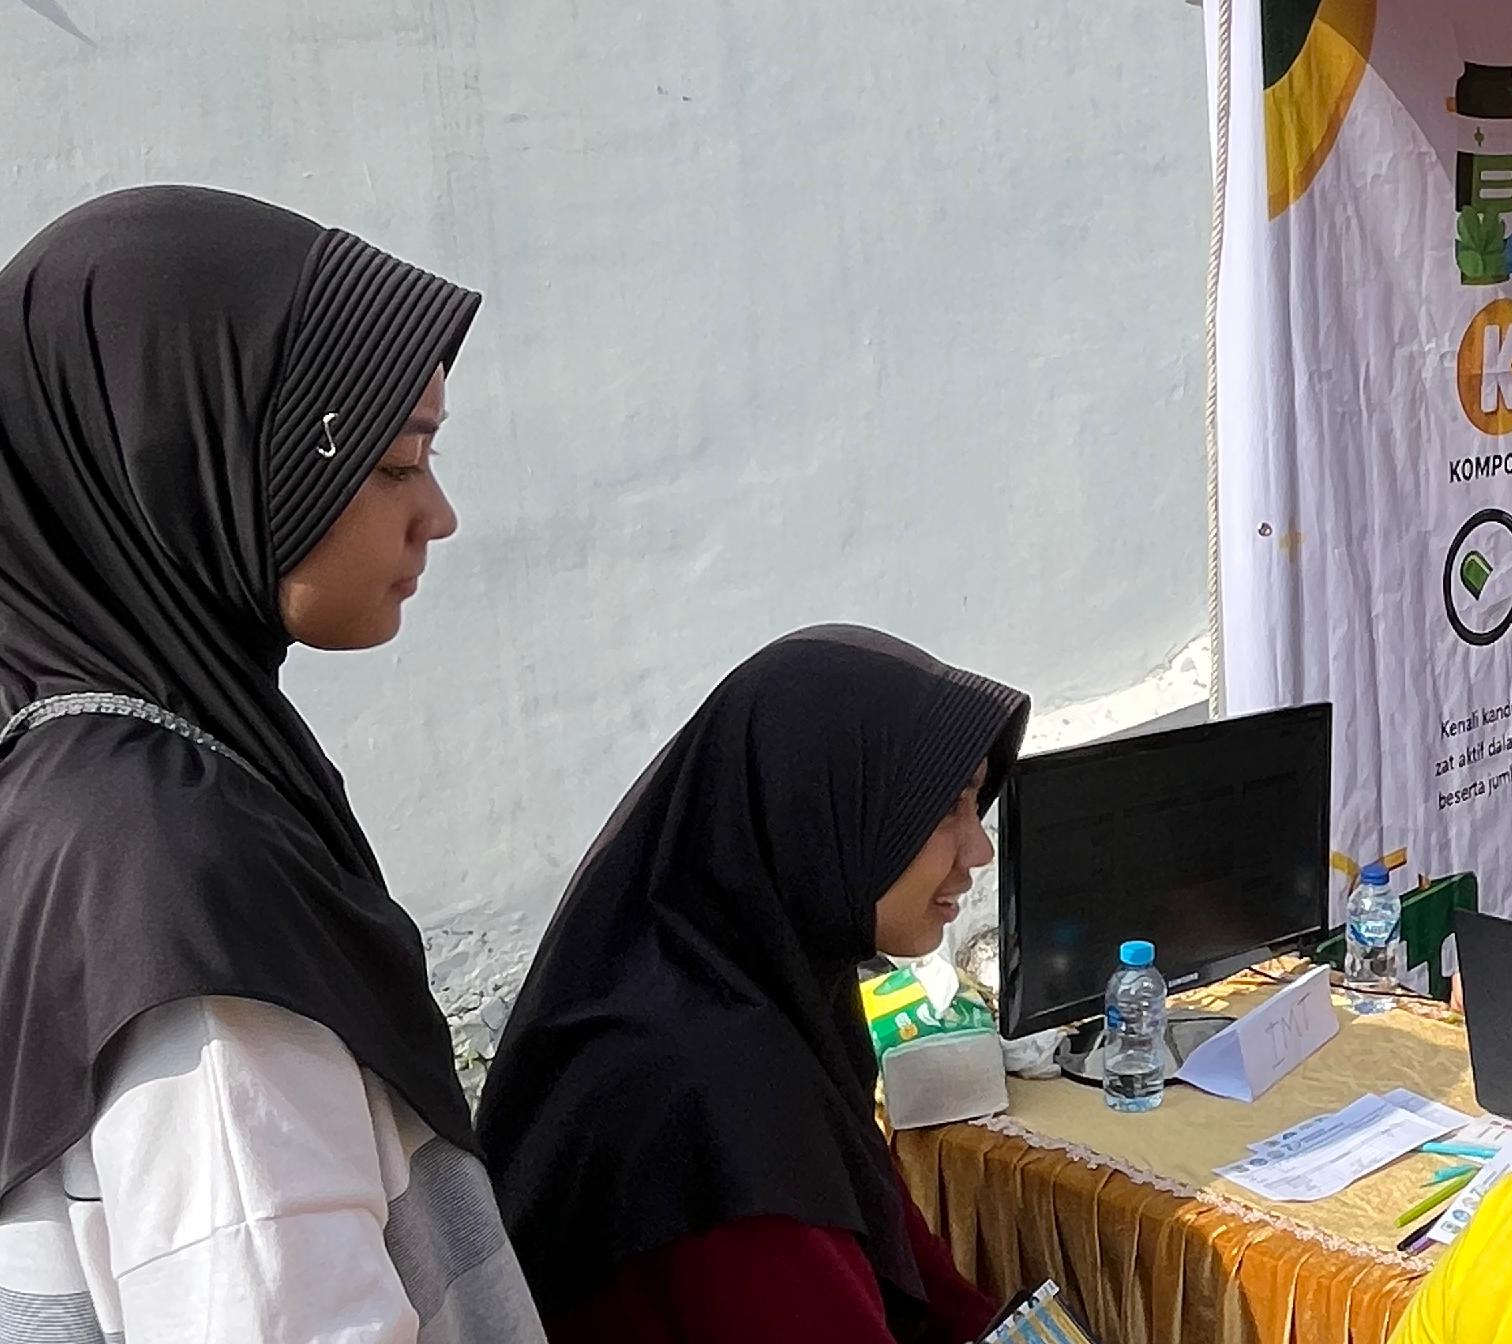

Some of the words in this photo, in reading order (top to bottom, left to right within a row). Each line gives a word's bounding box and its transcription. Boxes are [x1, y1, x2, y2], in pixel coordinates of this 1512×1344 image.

[1440, 709, 1479, 739] Kenali
[1435, 756, 1454, 777] zat
[1458, 741, 1484, 768] aktif
[1438, 781, 1485, 810] beserta
